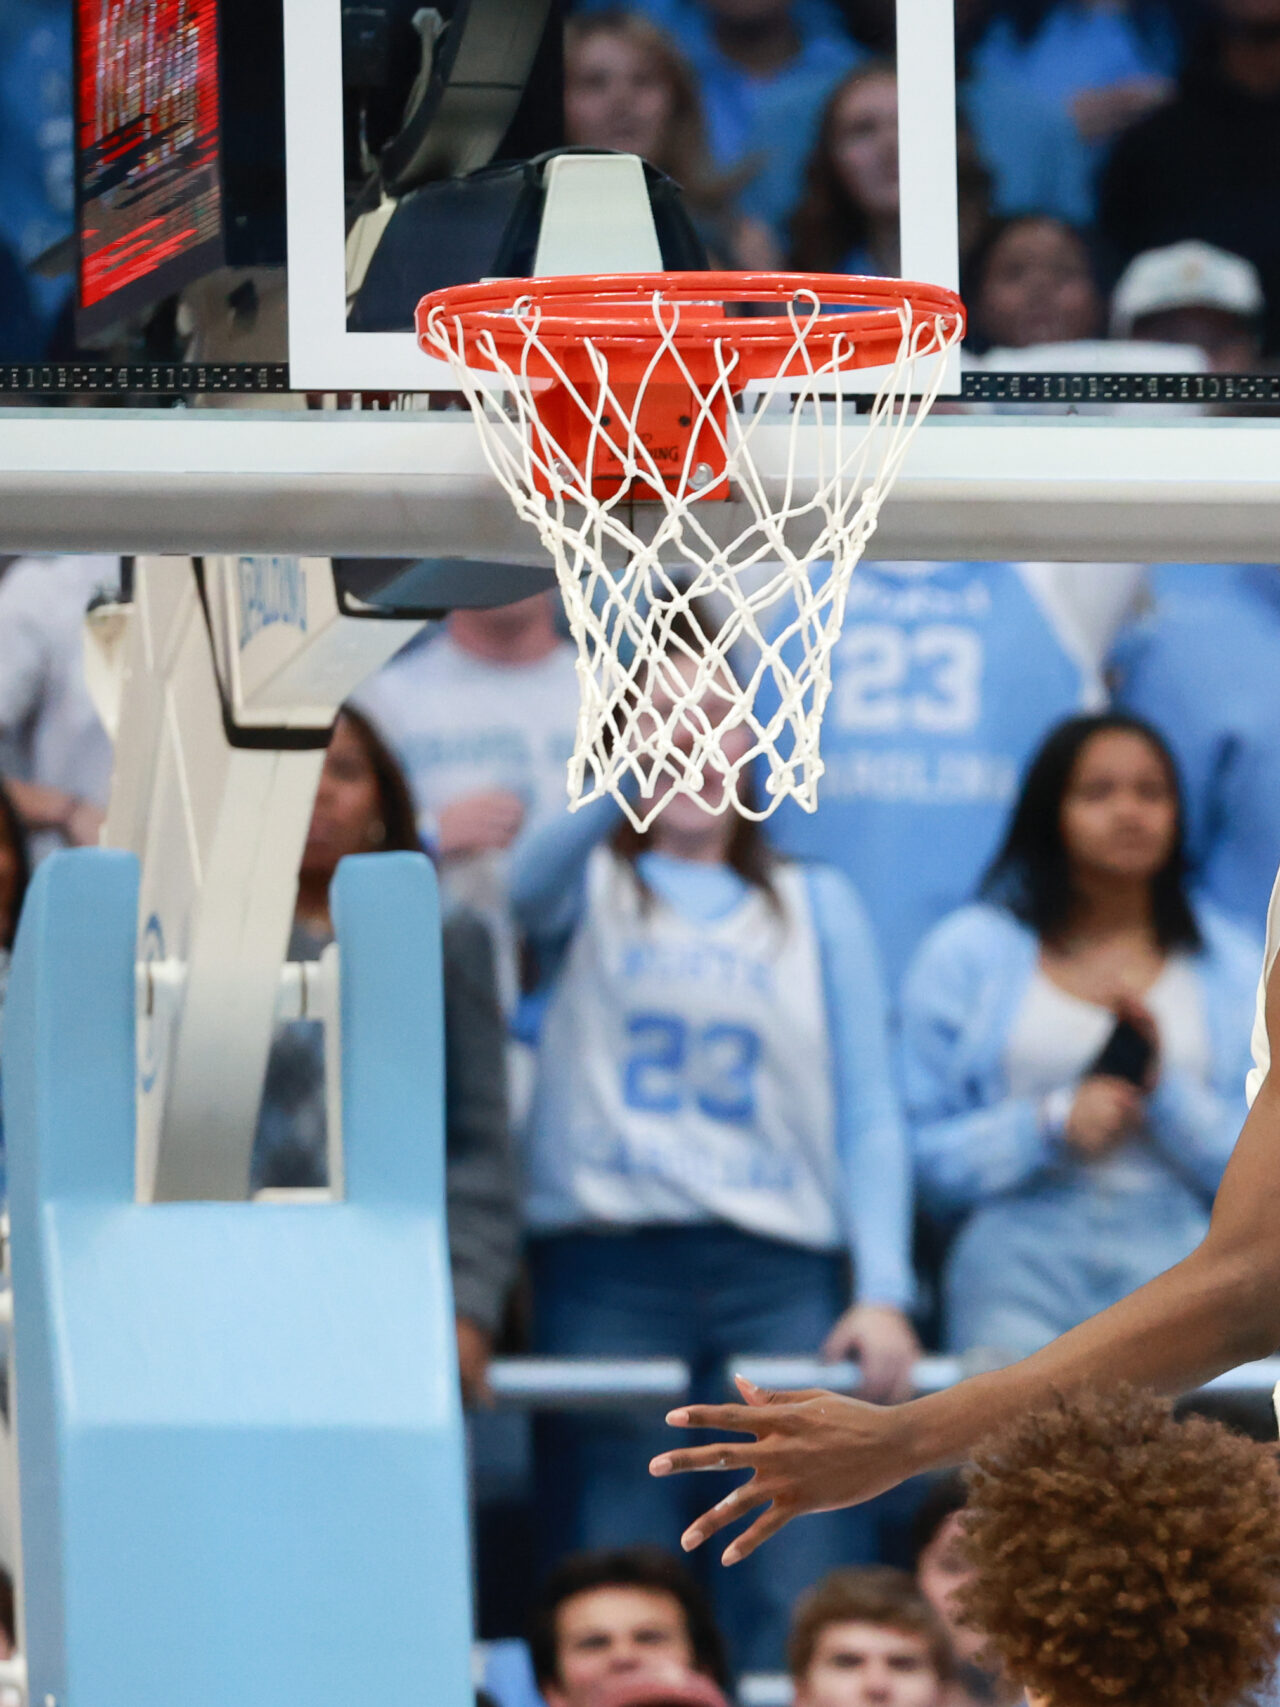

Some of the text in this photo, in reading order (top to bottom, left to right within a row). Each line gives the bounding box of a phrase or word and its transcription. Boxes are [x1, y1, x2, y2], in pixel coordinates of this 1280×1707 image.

[607, 446, 679, 462] SLING
[833, 624, 982, 733] 23
[623, 1012, 763, 1122] 23
